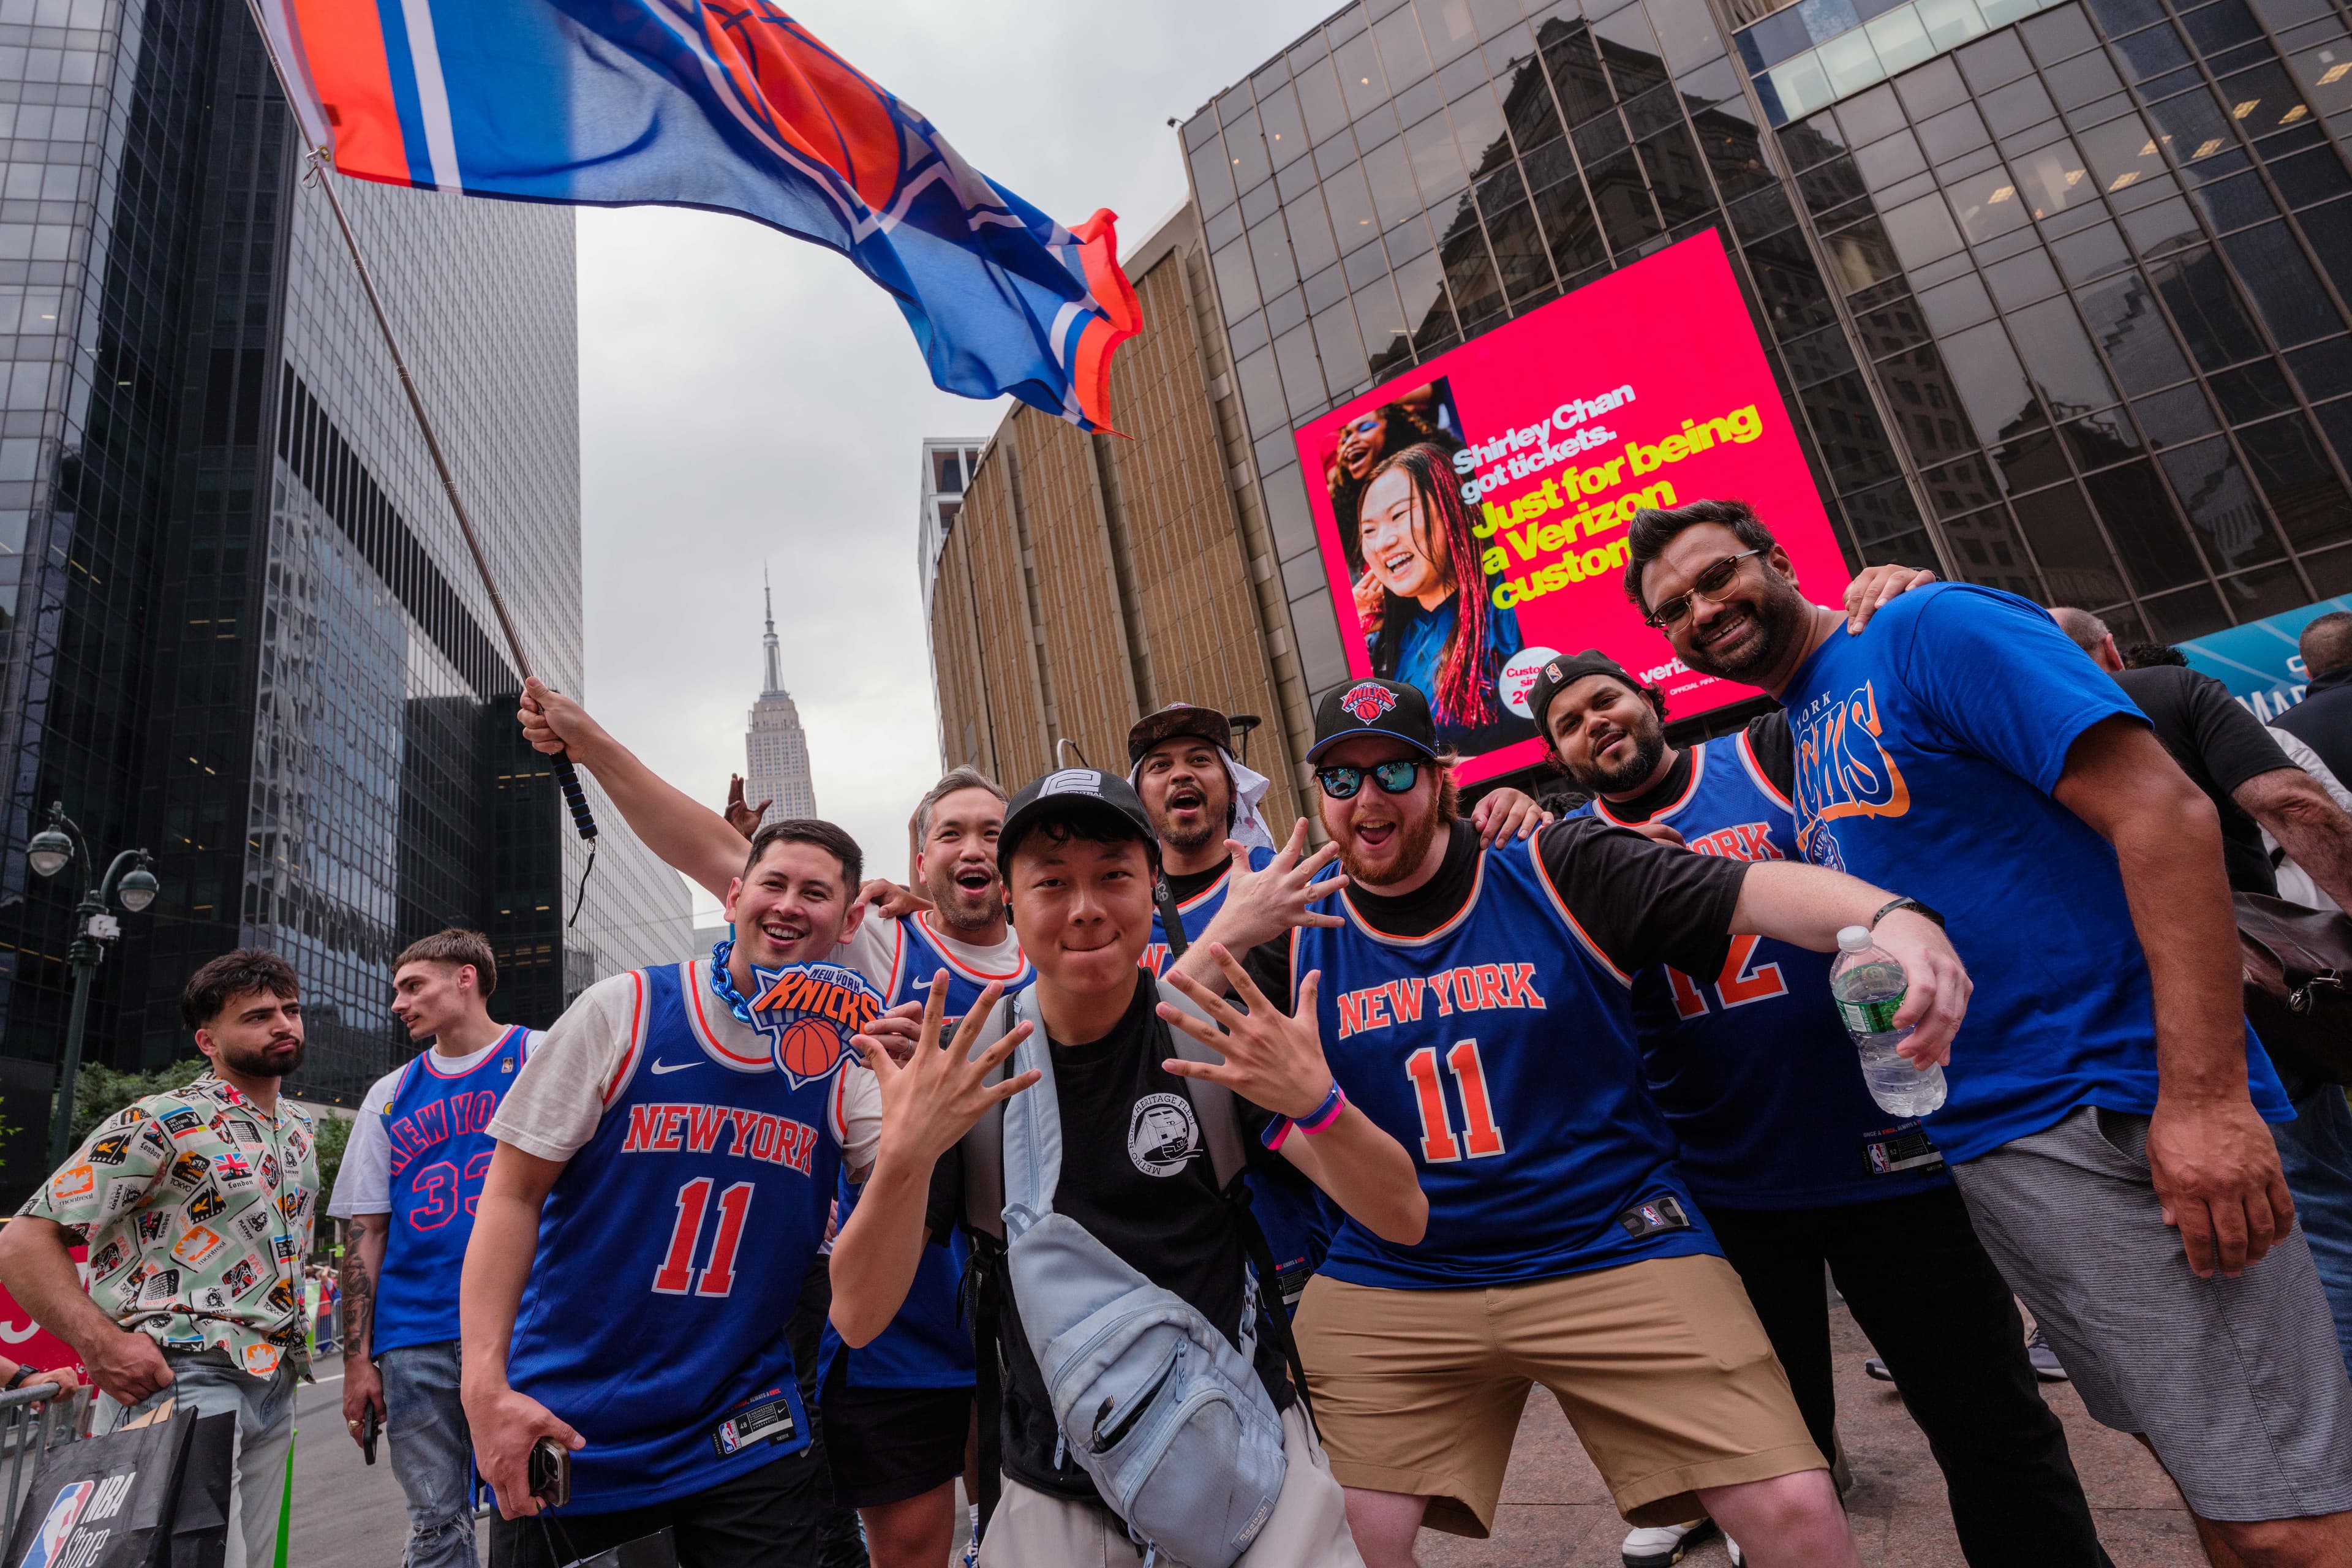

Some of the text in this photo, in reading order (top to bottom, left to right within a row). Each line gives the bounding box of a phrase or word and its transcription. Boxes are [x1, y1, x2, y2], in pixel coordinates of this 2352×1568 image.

[1453, 384, 1636, 474] Shirley Chan
[1461, 424, 1618, 504] got tickets.
[1471, 404, 1763, 539] Just for being
[1482, 480, 1678, 576] a Verizon
[1506, 666, 1544, 677] Custo
[1520, 677, 1537, 687] sin
[1639, 657, 1692, 684] veriz
[1343, 686, 1395, 709] KNICKS
[1670, 682, 1699, 696] OFFICIAL
[1700, 676, 1714, 686] FIFA
[1797, 690, 1831, 729] YORK
[1686, 821, 1785, 862] ORK
[809, 968, 861, 993] NEW YORK
[754, 971, 879, 1035] KNICKS
[1337, 963, 1547, 1040] NEW YORK
[450, 1089, 510, 1136] YO
[1134, 1095, 1197, 1126] HERITAGE FLEET
[1405, 1038, 1506, 1164] 11
[170, 1118, 190, 1128] PLAYBOY
[139, 1141, 162, 1160] London
[620, 1102, 818, 1179] NEW YORK
[170, 1178, 192, 1193] TOKYO
[228, 1180, 254, 1189] London
[59, 1193, 94, 1207] montreal
[158, 1213, 172, 1239] London
[238, 1219, 254, 1241] PLAYBOY
[651, 1176, 753, 1298] 11
[197, 1241, 227, 1266] montreal
[263, 1301, 284, 1317] TOKYO
[80, 1471, 137, 1525] NBA
[56, 1526, 111, 1568] Store
